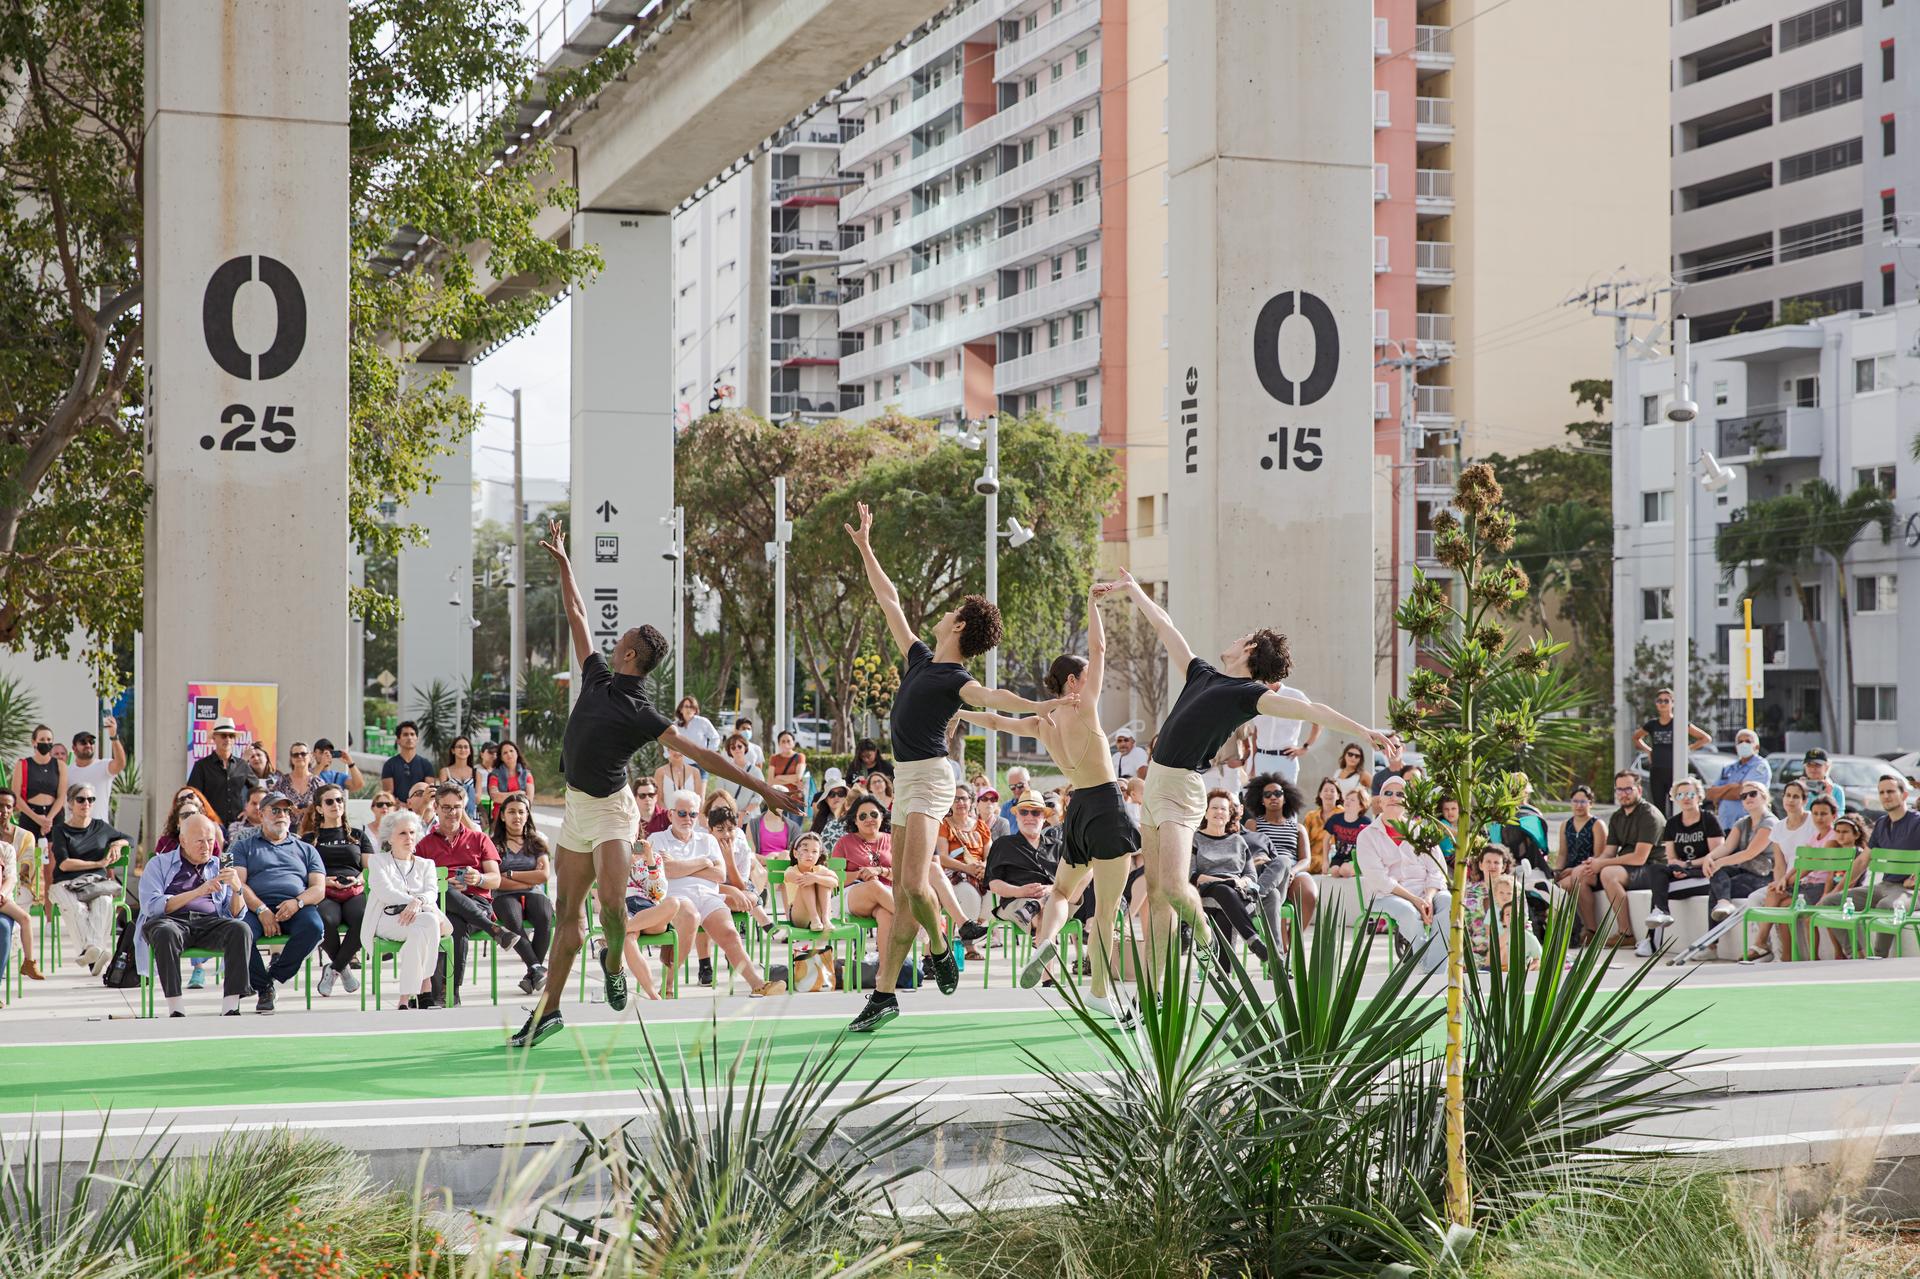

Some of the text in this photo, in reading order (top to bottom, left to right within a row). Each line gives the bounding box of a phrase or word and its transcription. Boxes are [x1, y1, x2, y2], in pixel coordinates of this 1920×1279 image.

[203, 255, 307, 380] 0
[1254, 290, 1339, 406] 0
[200, 404, 296, 453] .25
[1181, 366, 1198, 474] mile
[1260, 427, 1323, 472] .15
[594, 588, 619, 655] ckell
[193, 729, 207, 744] TO
